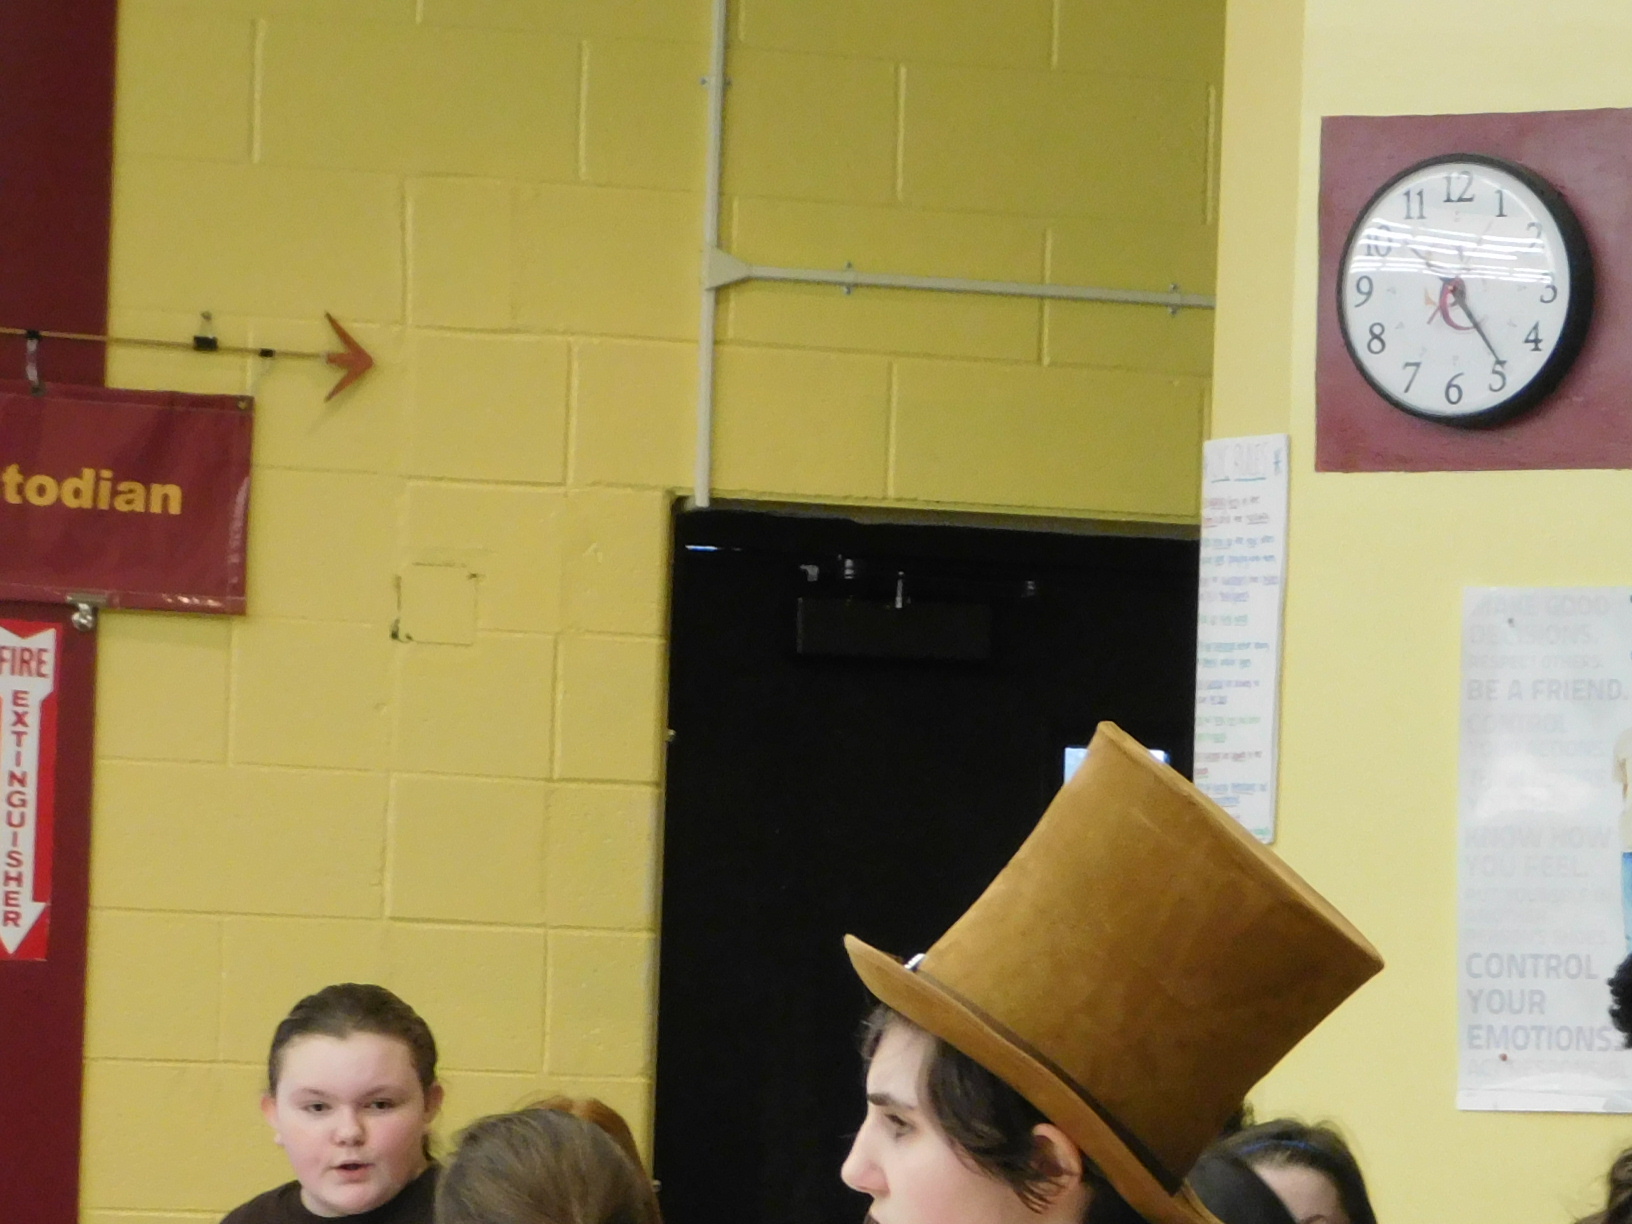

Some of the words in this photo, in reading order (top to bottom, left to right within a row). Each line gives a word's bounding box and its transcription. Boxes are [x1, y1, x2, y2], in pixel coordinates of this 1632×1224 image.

[1443, 171, 1475, 203] 12
[1402, 188, 1427, 220] 11
[1494, 190, 1508, 218] 1
[1366, 225, 1393, 258] 10
[1355, 275, 1374, 308] 9
[1539, 273, 1558, 304] 3
[1366, 322, 1386, 354] 8
[1524, 321, 1543, 352] 4
[1402, 362, 1422, 393] 7
[1444, 372, 1465, 405] 6
[1488, 360, 1508, 392] 5
[2, 463, 183, 515] todian
[0, 646, 50, 679] FIRE
[1466, 679, 1499, 702] BE
[1507, 679, 1524, 702] A
[1531, 679, 1629, 702] FRIEND.
[2, 689, 31, 928] EXTINGUISHER
[1465, 952, 1599, 980] CONTROL
[1466, 988, 1546, 1015] YOUR
